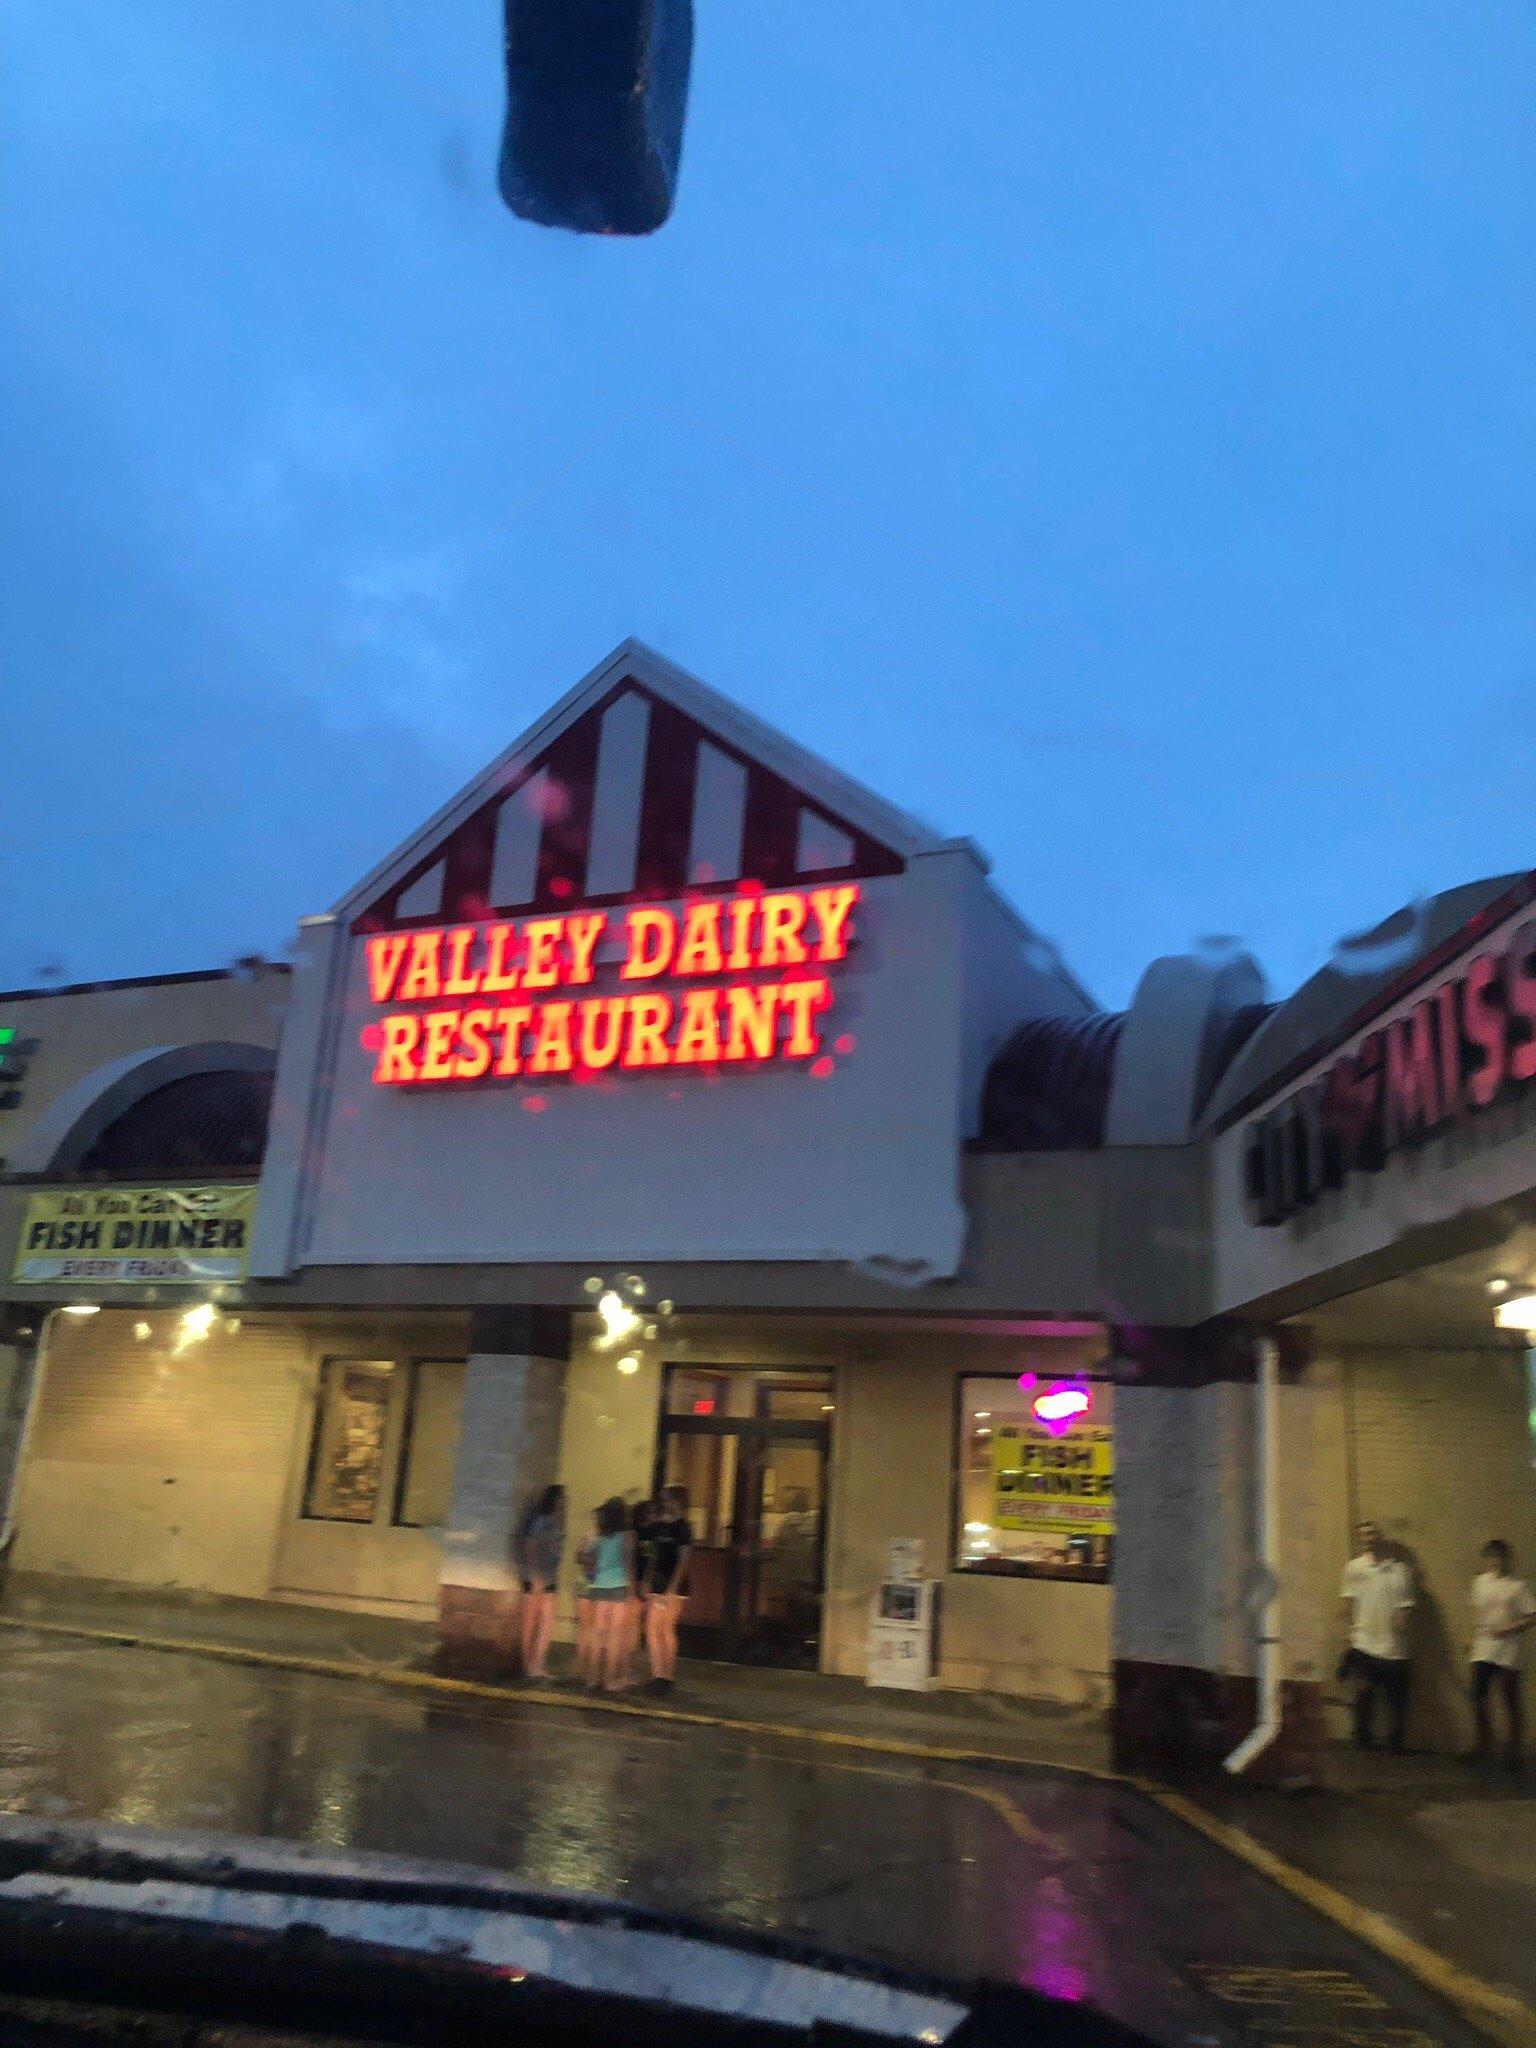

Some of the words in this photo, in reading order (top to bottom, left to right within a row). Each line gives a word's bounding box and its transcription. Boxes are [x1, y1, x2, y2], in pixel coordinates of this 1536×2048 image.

[366, 913, 607, 1002] VALLEY
[622, 886, 860, 980] DAIRY
[373, 979, 827, 1084] RESTAURANT
[28, 1221, 103, 1249] FISH
[112, 1219, 246, 1249] DINNER
